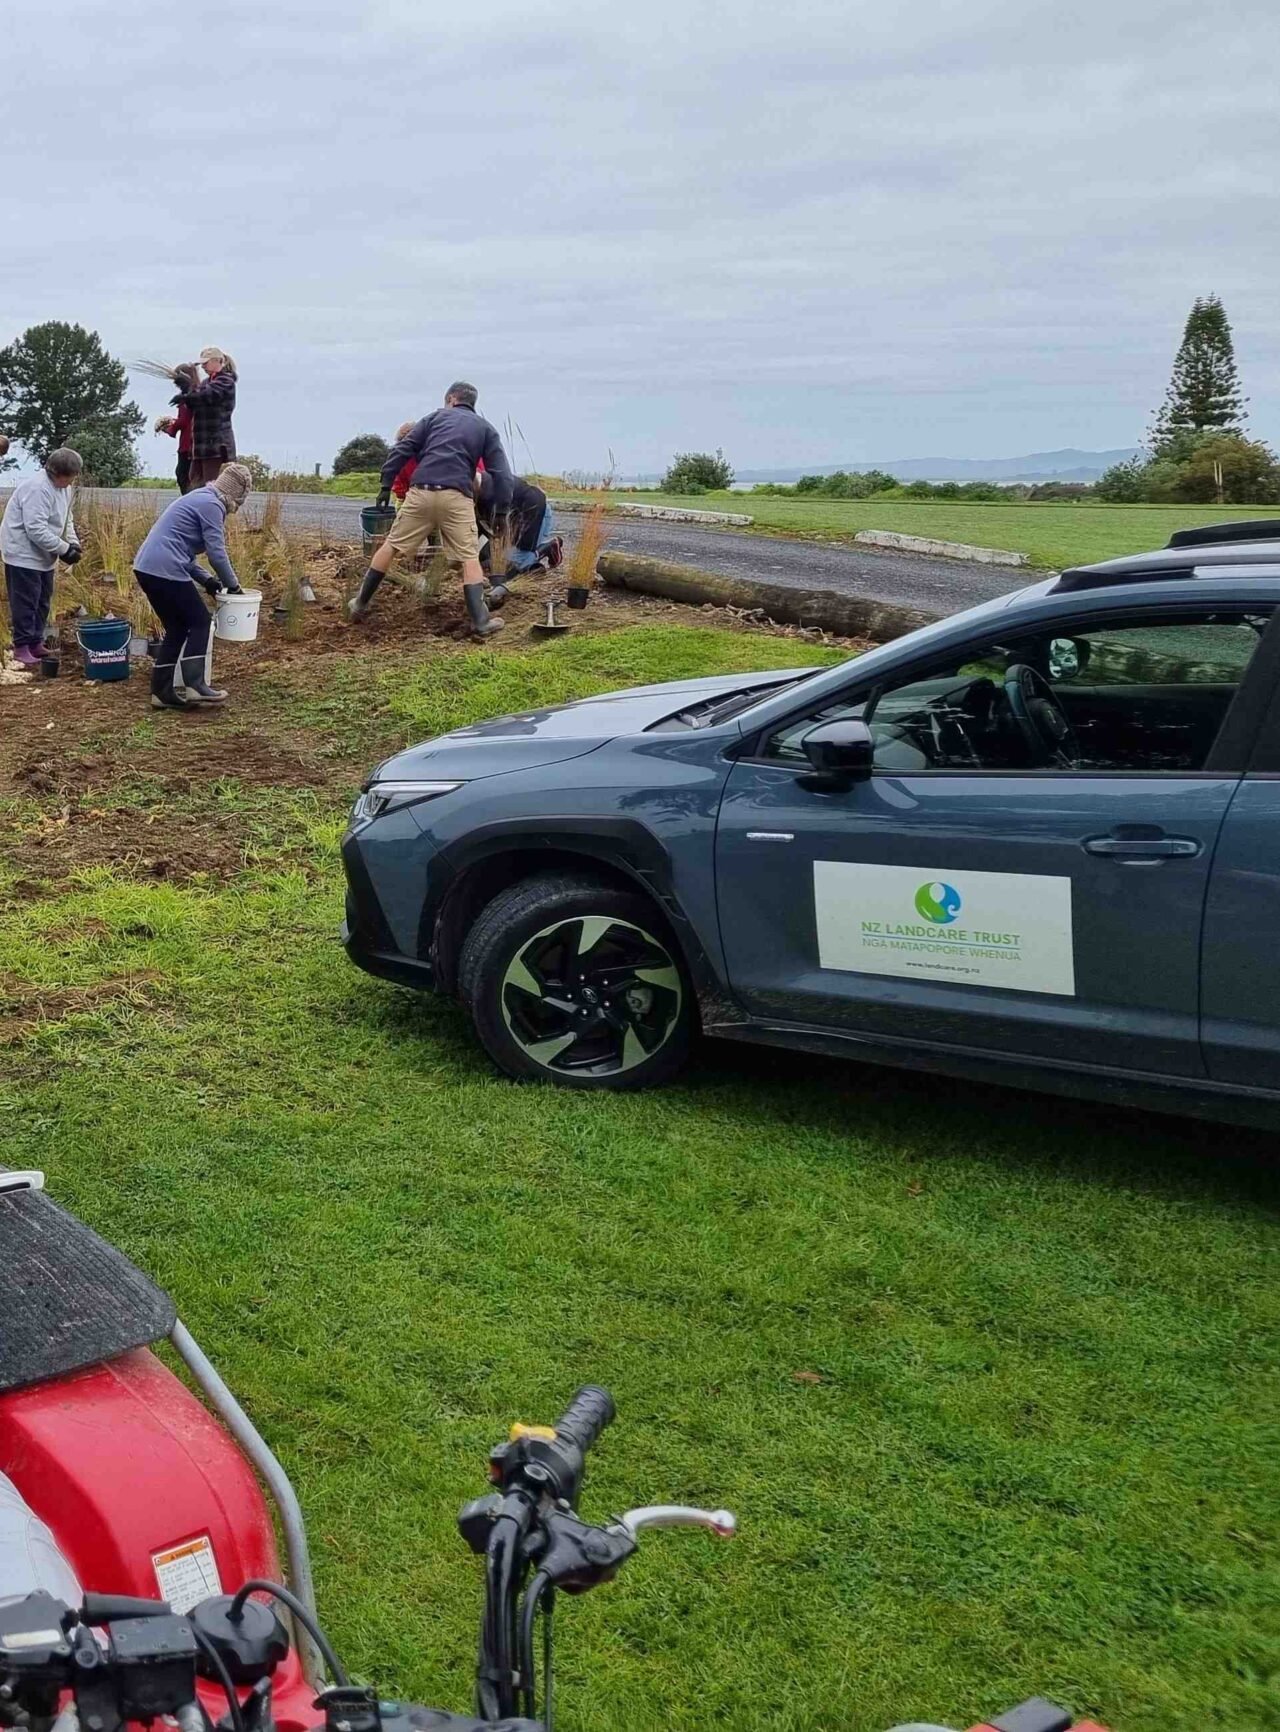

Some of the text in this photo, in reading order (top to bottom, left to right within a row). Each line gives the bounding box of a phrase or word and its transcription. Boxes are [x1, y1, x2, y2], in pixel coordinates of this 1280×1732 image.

[861, 922, 1020, 945] NZ LANDCARE TRUST
[890, 941, 966, 956] MATAPOPORE
[969, 949, 1022, 961] WHENUA
[905, 961, 980, 974] www.landcare.org.nz
